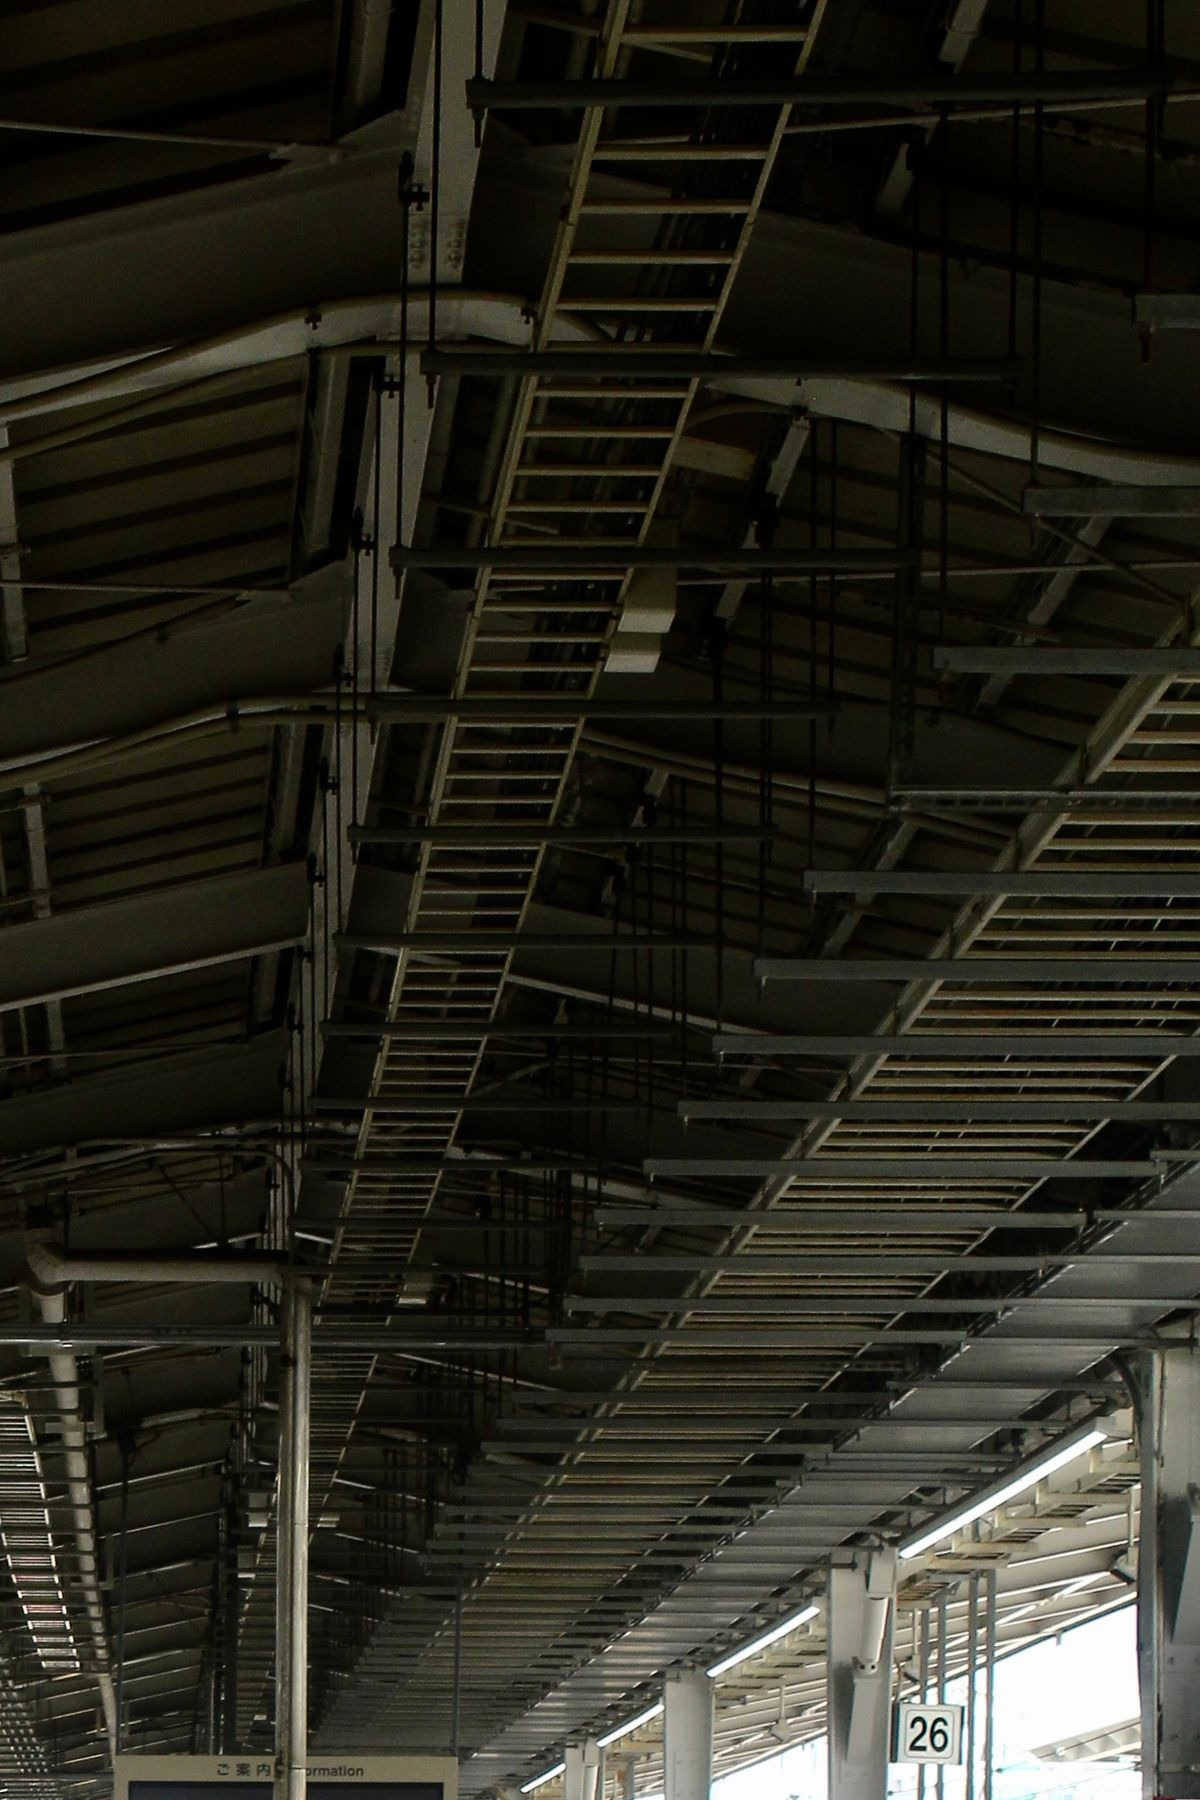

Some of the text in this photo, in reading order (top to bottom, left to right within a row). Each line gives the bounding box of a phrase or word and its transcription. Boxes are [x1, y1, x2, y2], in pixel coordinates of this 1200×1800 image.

[909, 1716, 949, 1753] 26
[217, 1763, 271, 1777] ご案内
[306, 1764, 364, 1777] ormation
